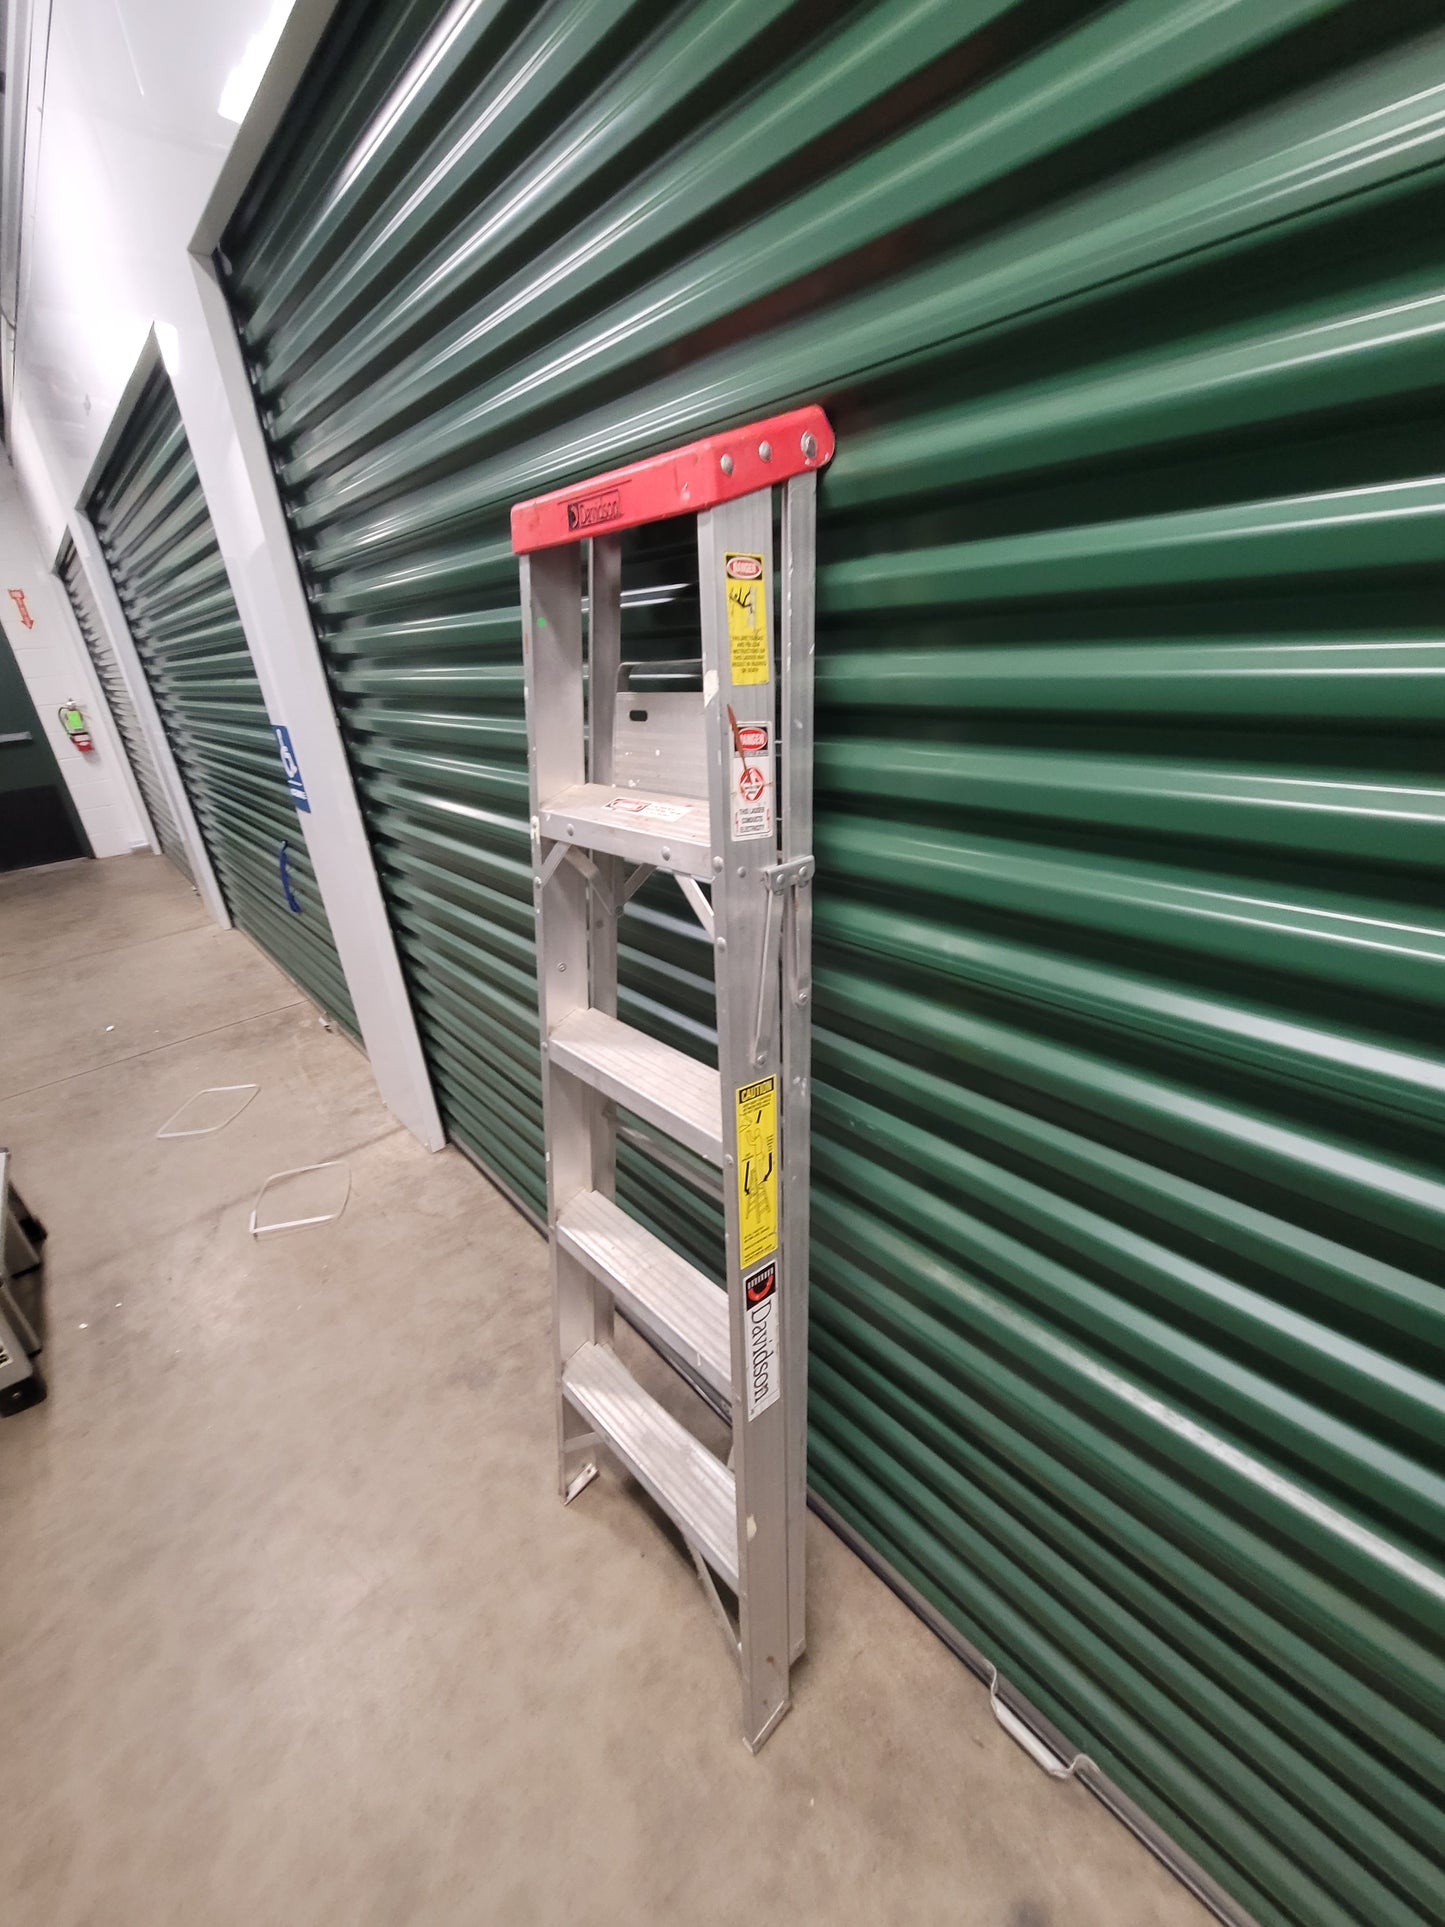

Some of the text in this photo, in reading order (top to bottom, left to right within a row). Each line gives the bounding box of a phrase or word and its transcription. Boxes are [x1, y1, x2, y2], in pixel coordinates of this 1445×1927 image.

[732, 560, 757, 575] DANGER
[741, 1080, 772, 1103] CAUTION
[751, 1299, 775, 1404] Davidson
